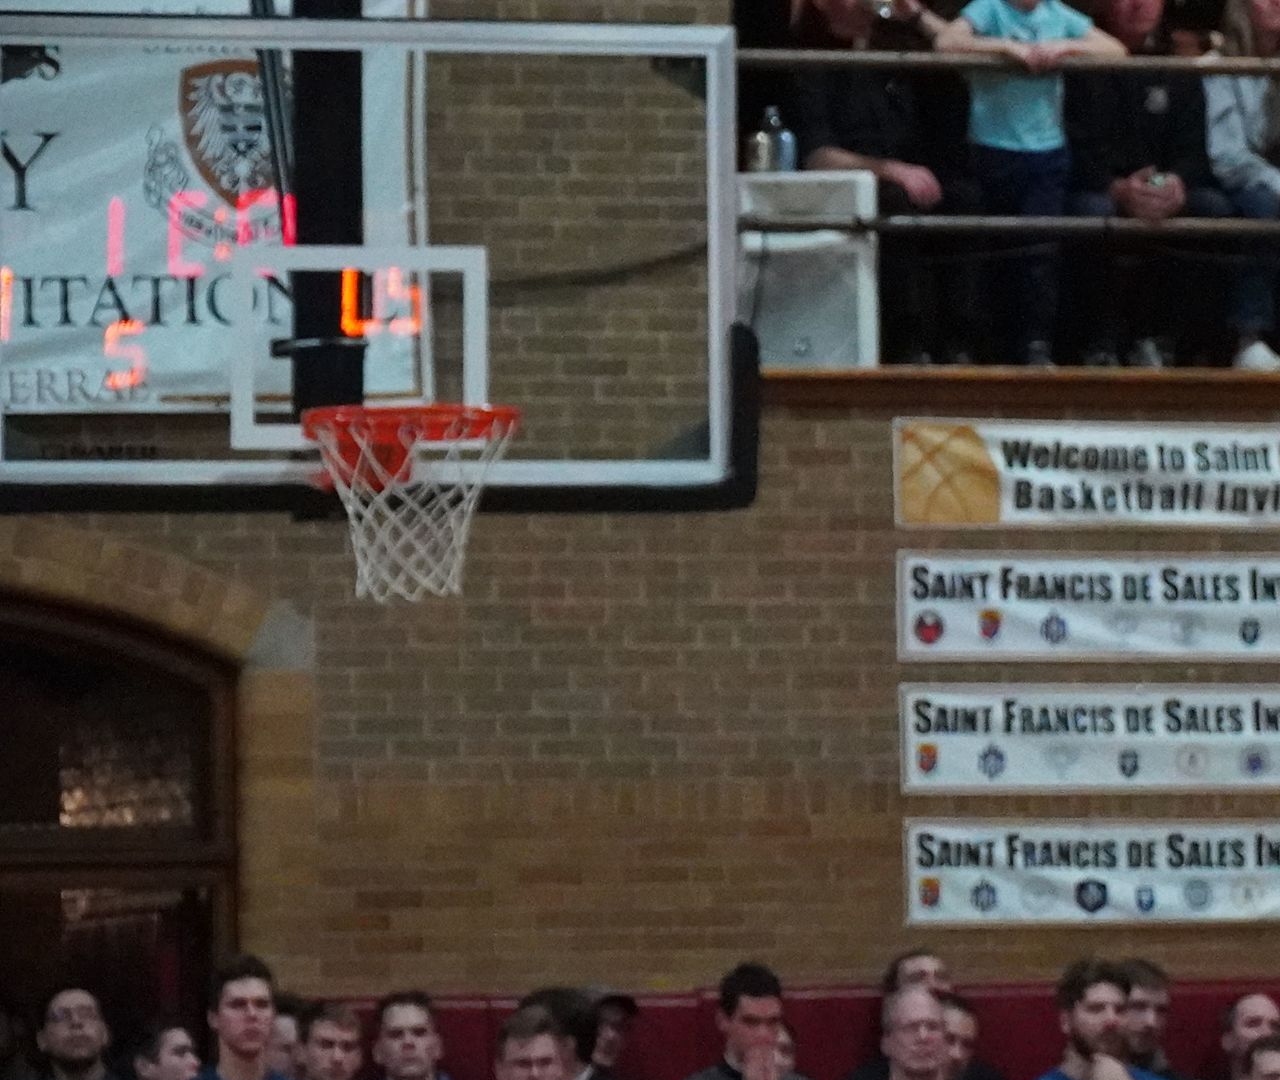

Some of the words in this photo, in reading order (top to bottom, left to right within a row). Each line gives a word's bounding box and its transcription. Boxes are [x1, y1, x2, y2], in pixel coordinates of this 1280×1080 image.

[1002, 440, 1149, 471] Welcome
[1157, 442, 1185, 471] to
[1194, 440, 1271, 472] Saint
[1014, 480, 1204, 511] Basketball
[912, 565, 990, 600] SAINT
[1000, 566, 1113, 601] FRANCIS
[1162, 567, 1240, 601] SALES
[913, 699, 993, 734] SAINT
[1002, 699, 1115, 734] FRANCIS
[1164, 699, 1244, 734] SALES
[917, 833, 996, 868] SAINT
[1005, 833, 1118, 868] FRANCIS
[1166, 833, 1245, 868] SALES
